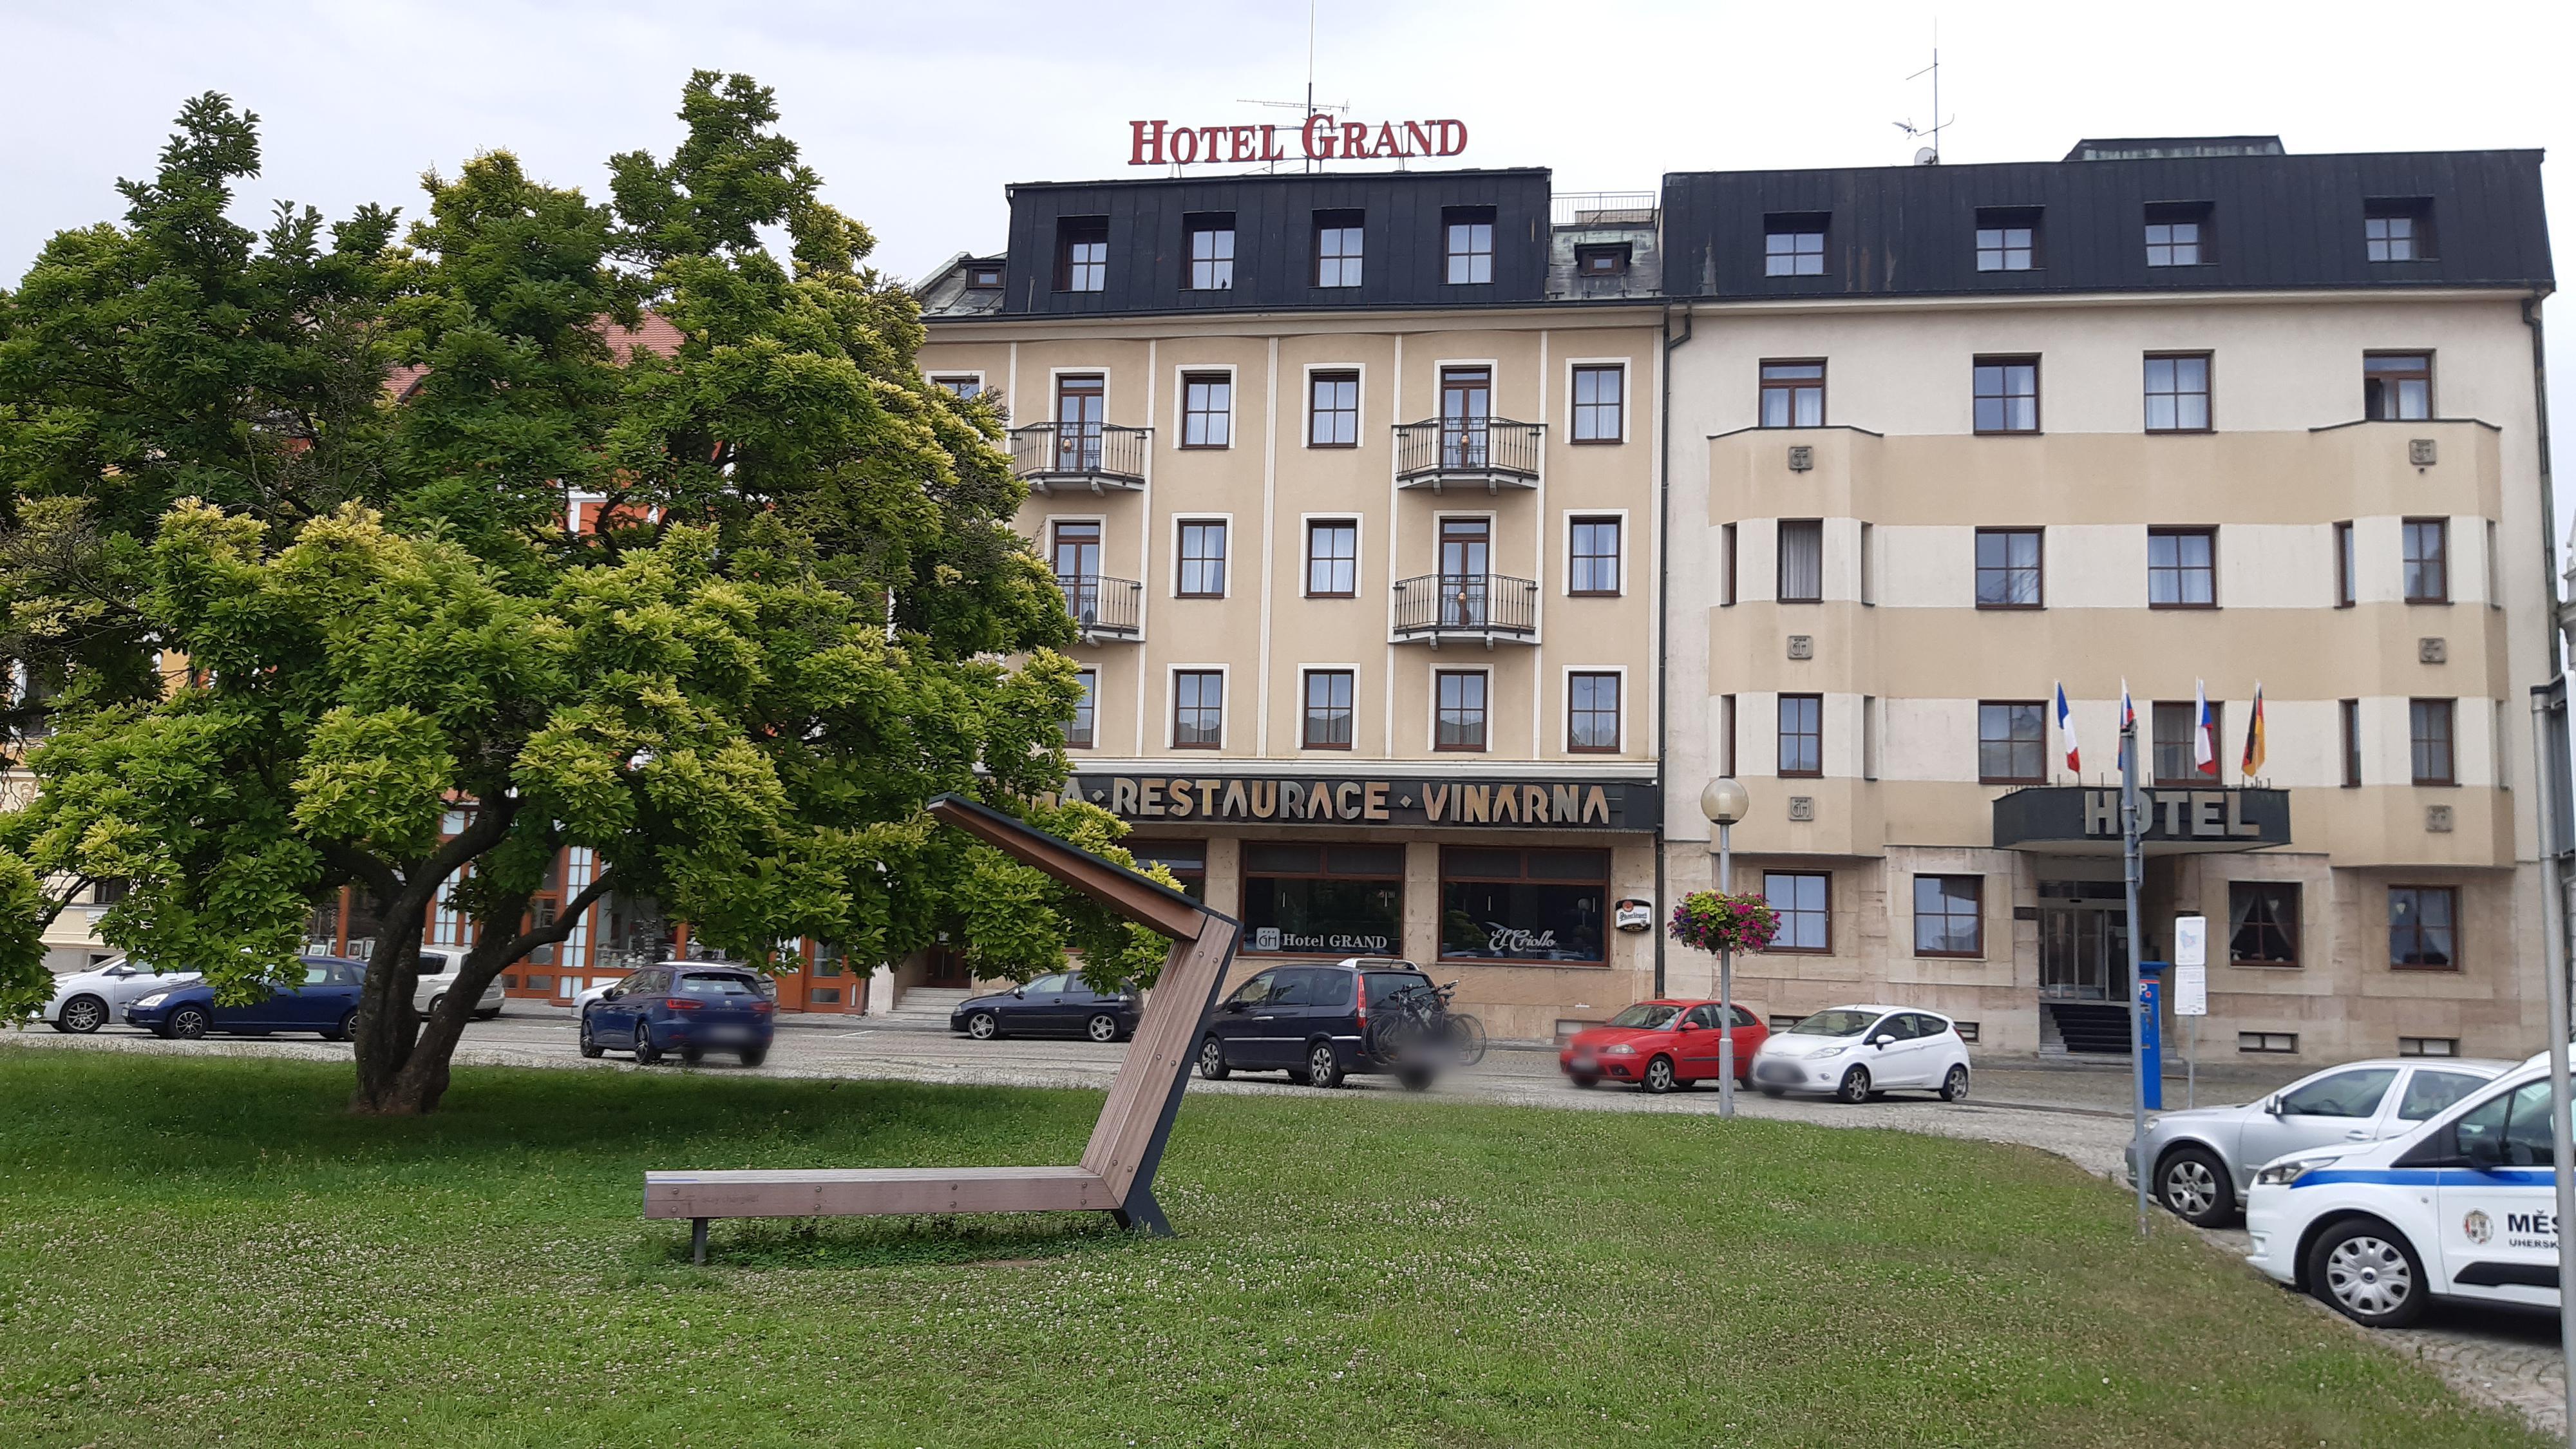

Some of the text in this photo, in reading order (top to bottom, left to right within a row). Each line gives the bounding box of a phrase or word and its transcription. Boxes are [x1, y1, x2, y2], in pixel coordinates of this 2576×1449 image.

[1128, 114, 1468, 165] HOTEL GRAND
[1112, 777, 1390, 820] RESTAURACE
[1283, 934, 1387, 949] Hotel GRAND
[1488, 929, 1557, 952] El Criollo
